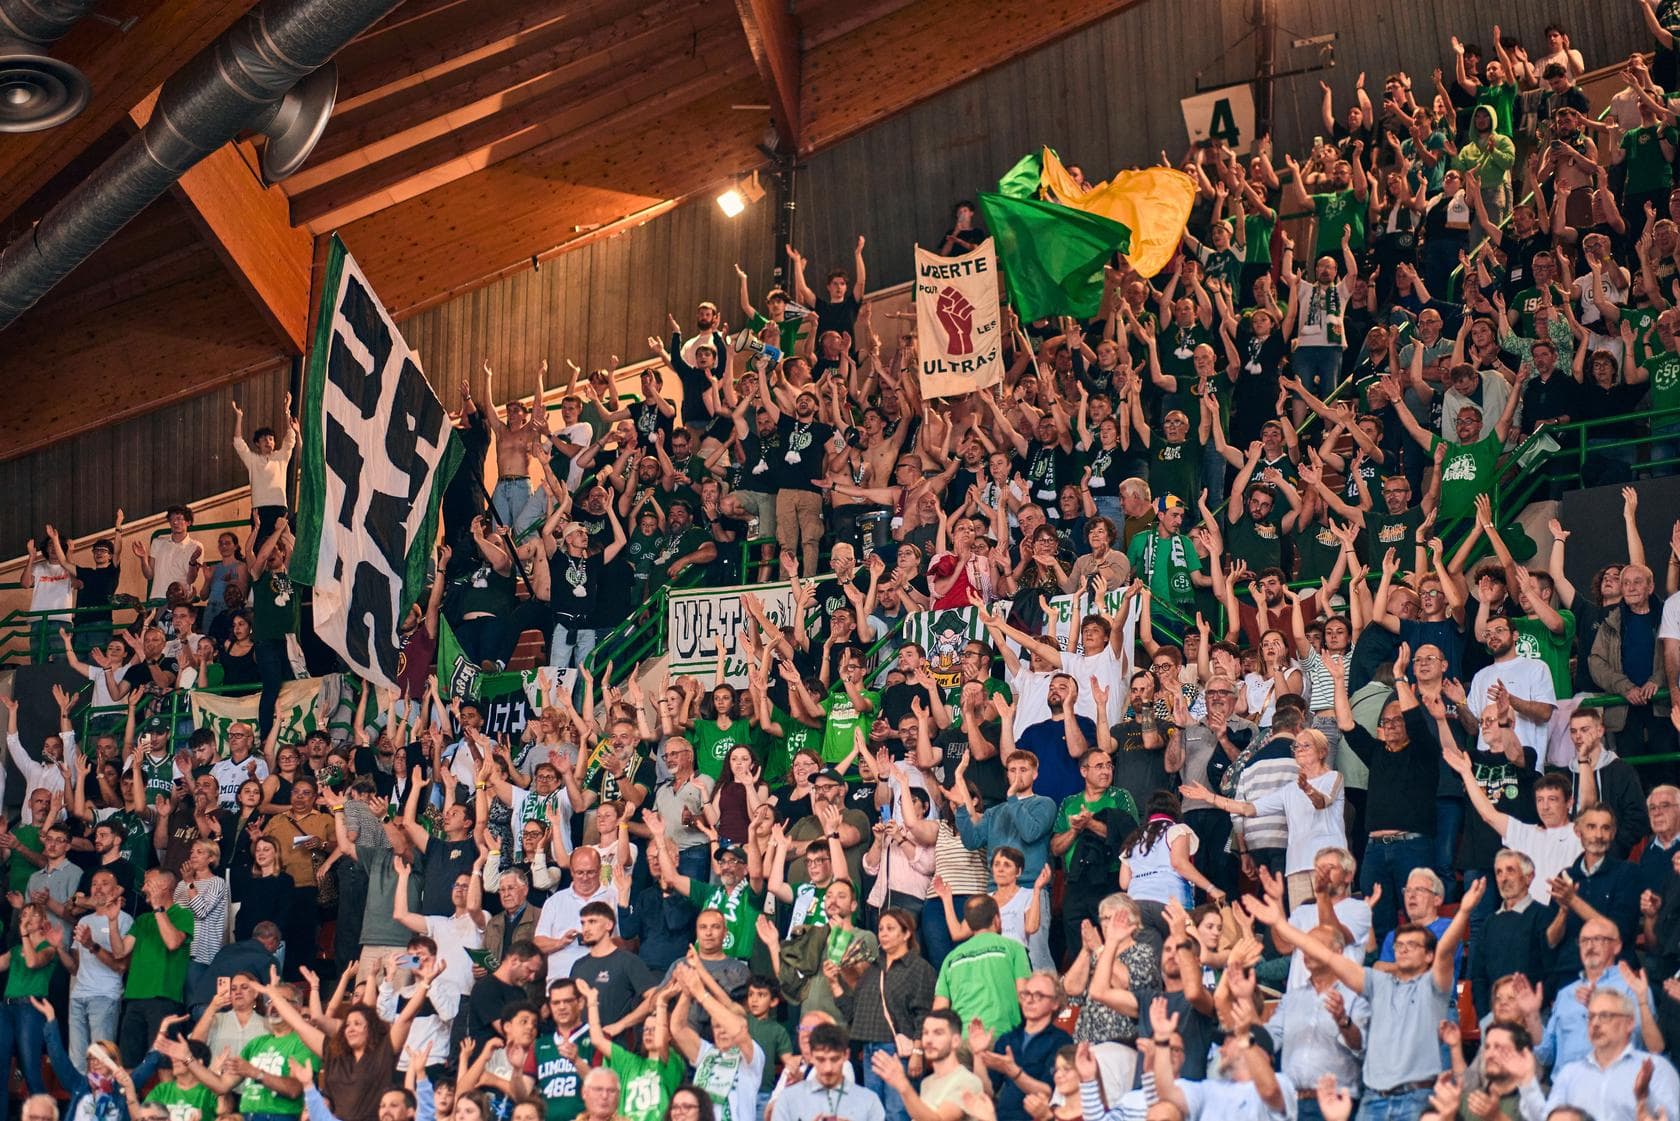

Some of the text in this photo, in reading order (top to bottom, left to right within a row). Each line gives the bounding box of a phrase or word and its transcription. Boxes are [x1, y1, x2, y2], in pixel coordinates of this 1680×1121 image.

[923, 347, 998, 375] ULTRAS
[1656, 364, 1680, 383] CSP
[543, 1075, 577, 1099] 482
